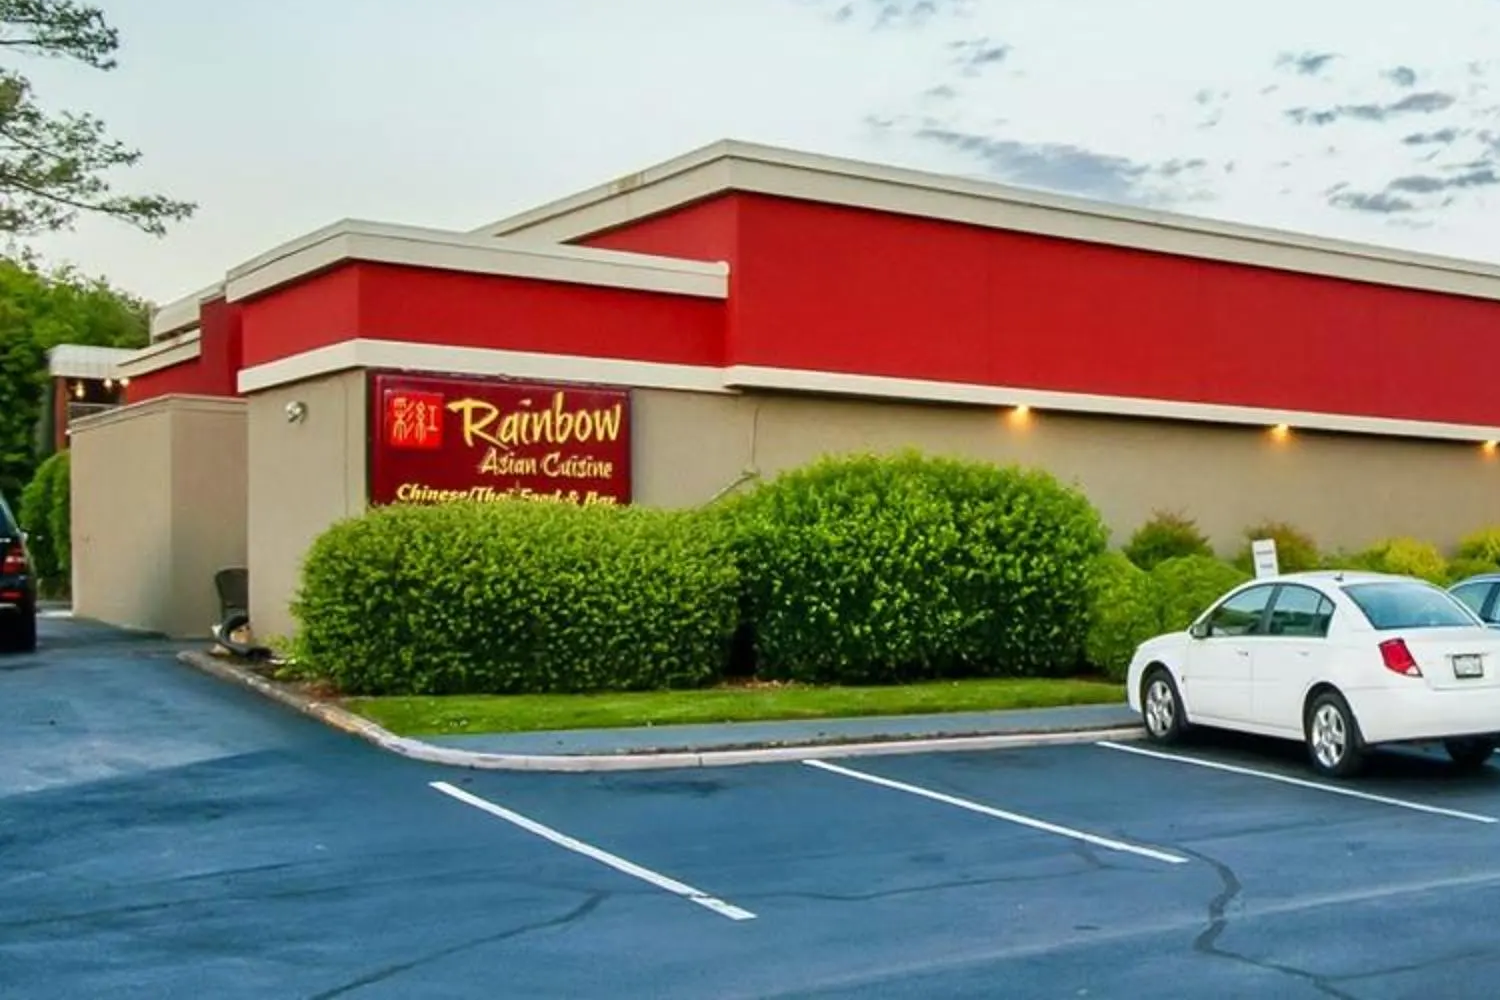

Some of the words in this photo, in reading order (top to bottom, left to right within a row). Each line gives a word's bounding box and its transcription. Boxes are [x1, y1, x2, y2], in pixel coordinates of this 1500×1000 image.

[447, 391, 622, 449] Rainbow
[478, 448, 537, 475] Asian
[540, 452, 613, 479] Cuisine
